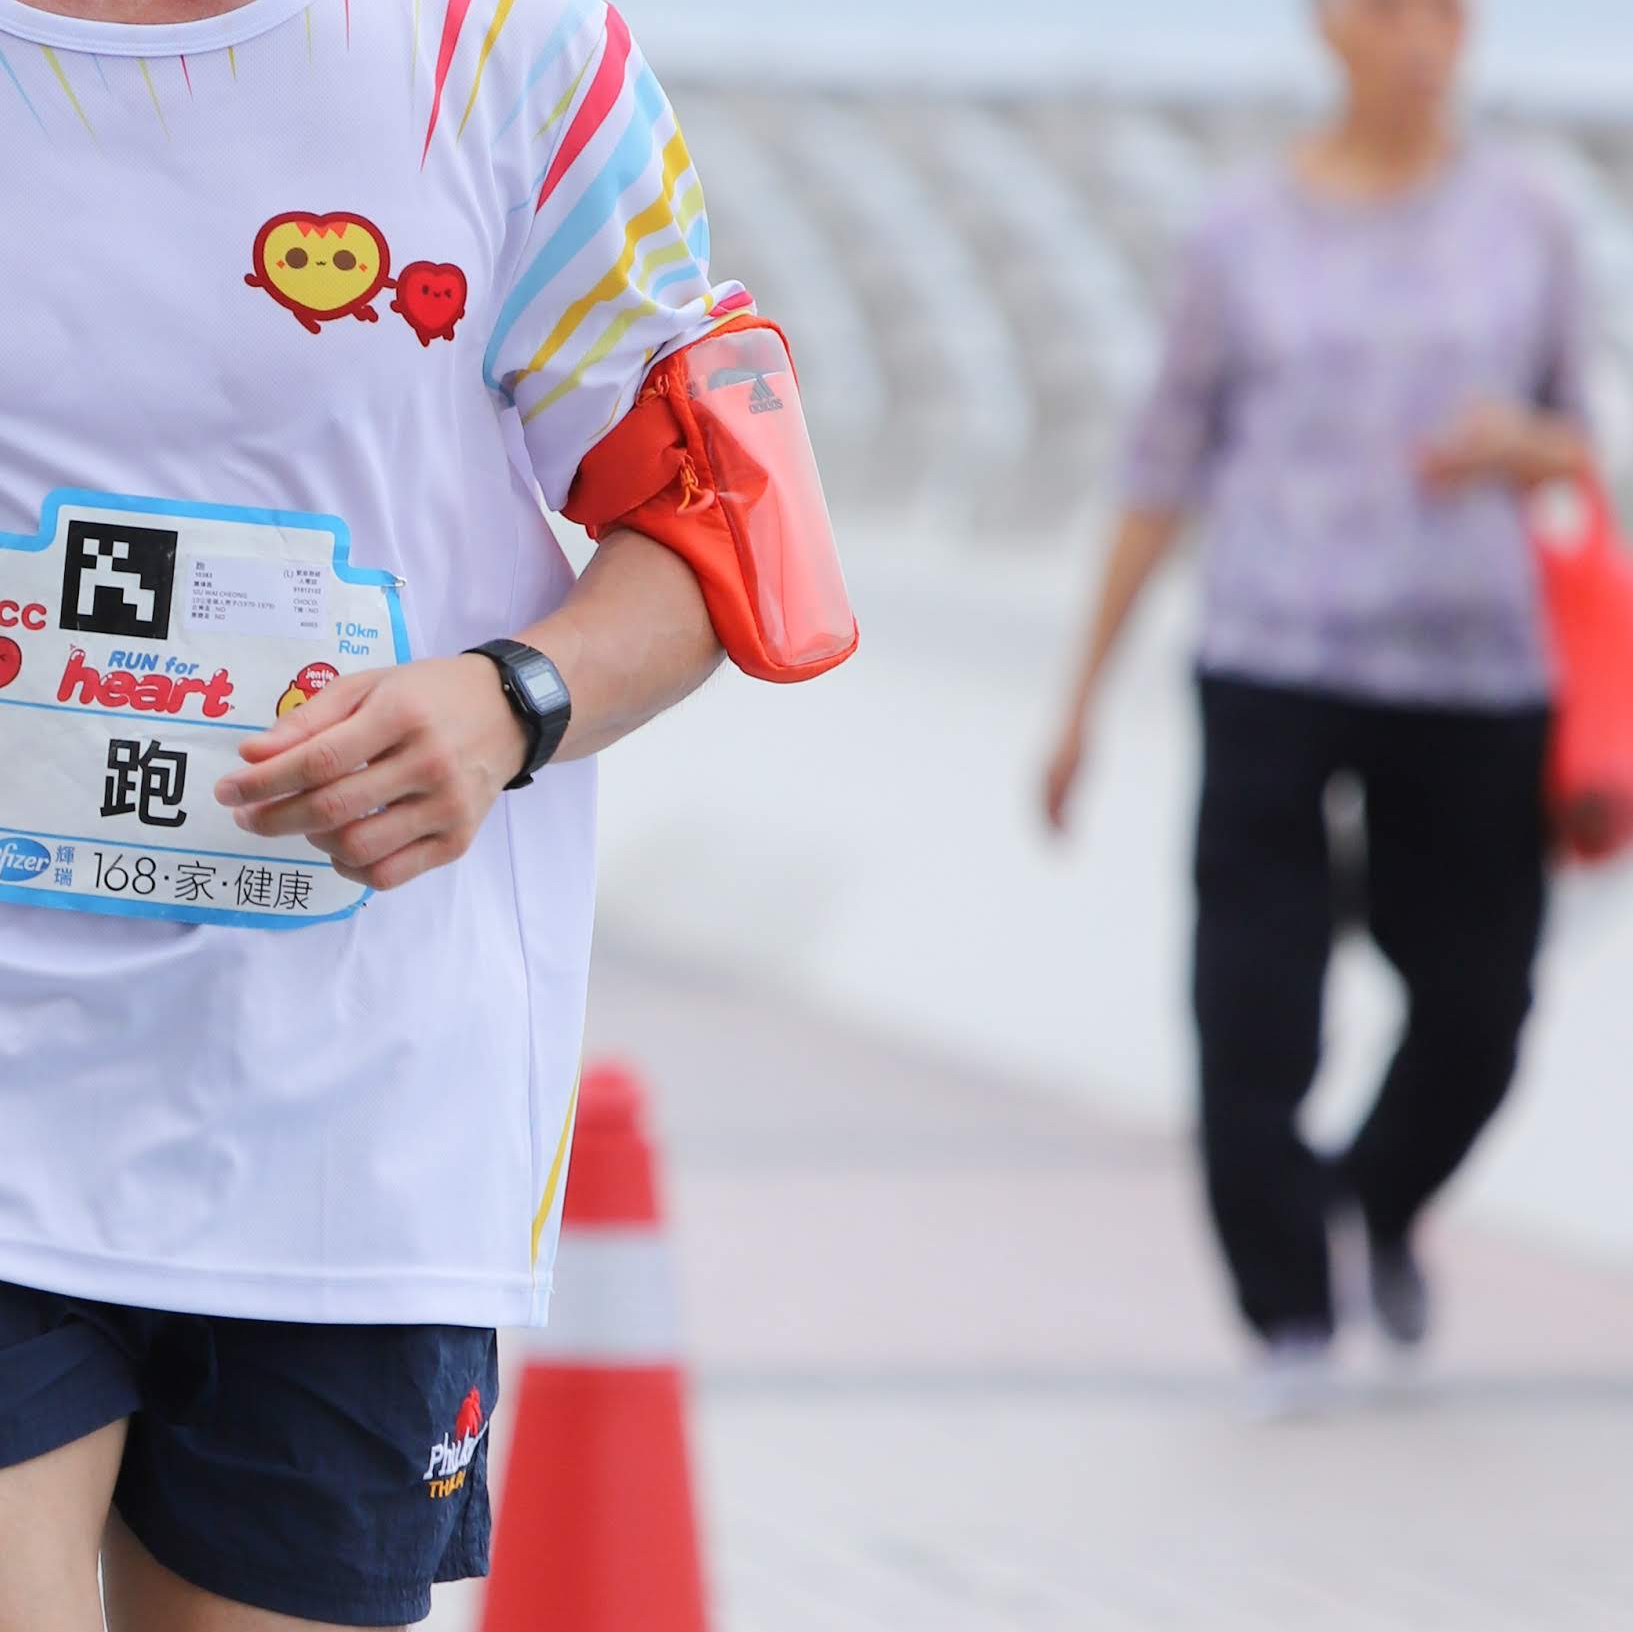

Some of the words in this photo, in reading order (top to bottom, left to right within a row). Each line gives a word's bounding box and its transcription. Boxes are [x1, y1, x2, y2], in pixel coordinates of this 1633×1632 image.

[336, 622, 379, 639] 10km
[339, 640, 370, 655] Run
[108, 650, 159, 671] RUN
[165, 656, 200, 675] for
[57, 648, 234, 718] heart
[99, 738, 187, 828] 跑
